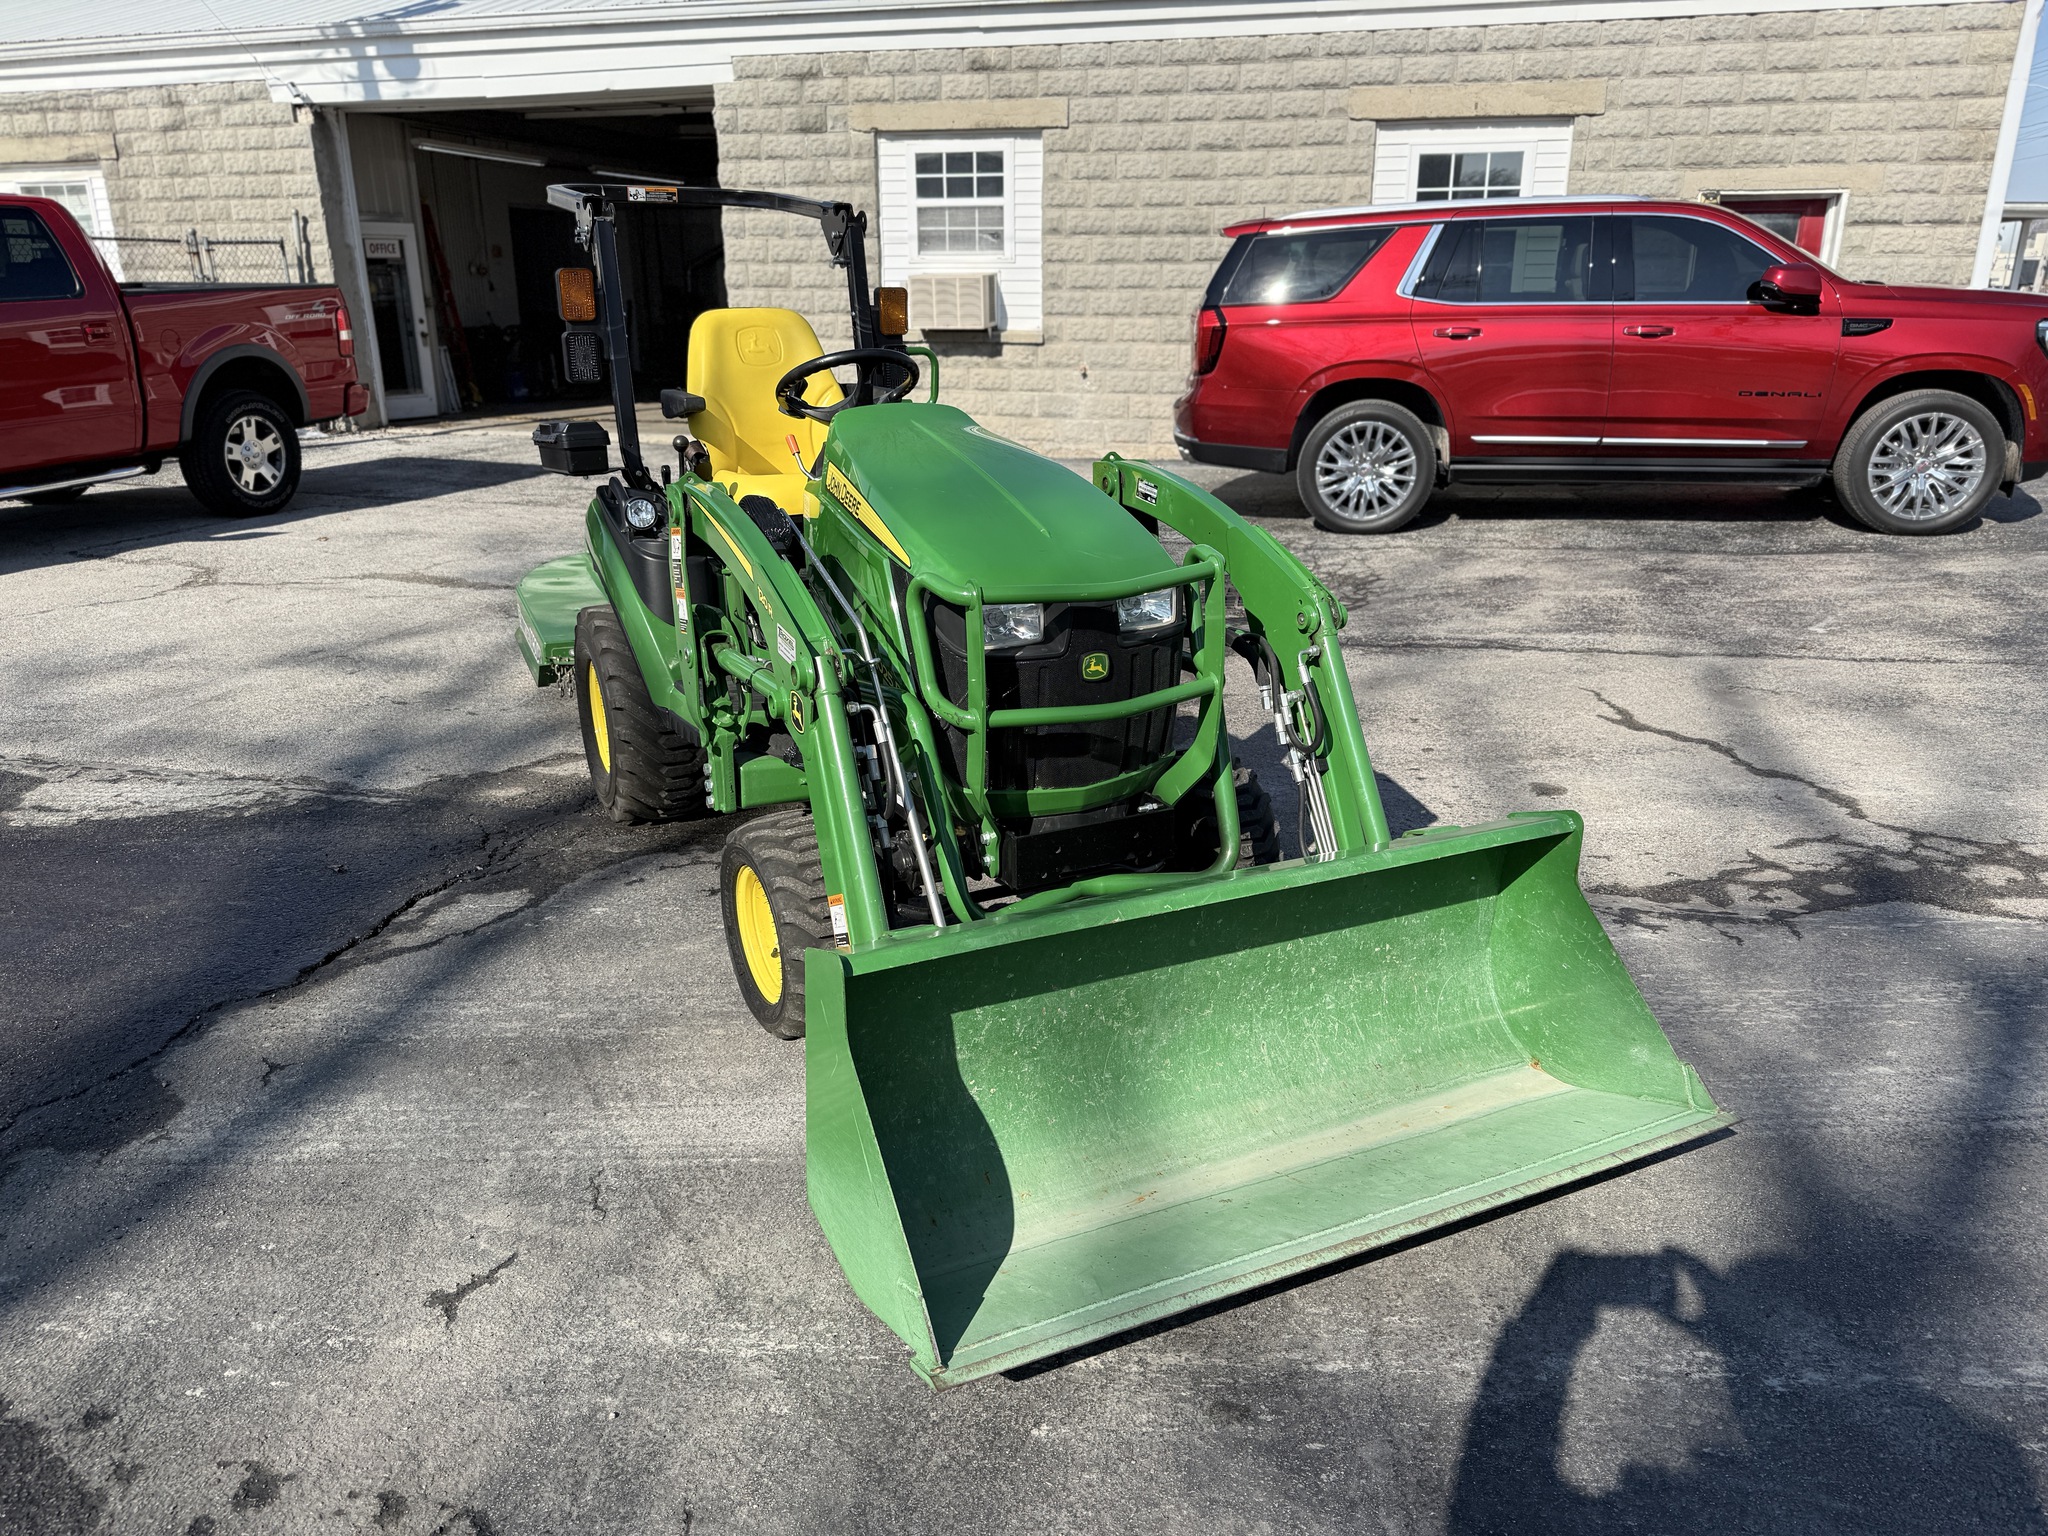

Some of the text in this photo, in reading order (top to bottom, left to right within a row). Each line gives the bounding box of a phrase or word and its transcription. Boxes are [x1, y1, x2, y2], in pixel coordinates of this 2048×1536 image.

[369, 242, 397, 254] OFFICE
[827, 472, 842, 499] JOHN
[840, 482, 862, 517] DEERE
